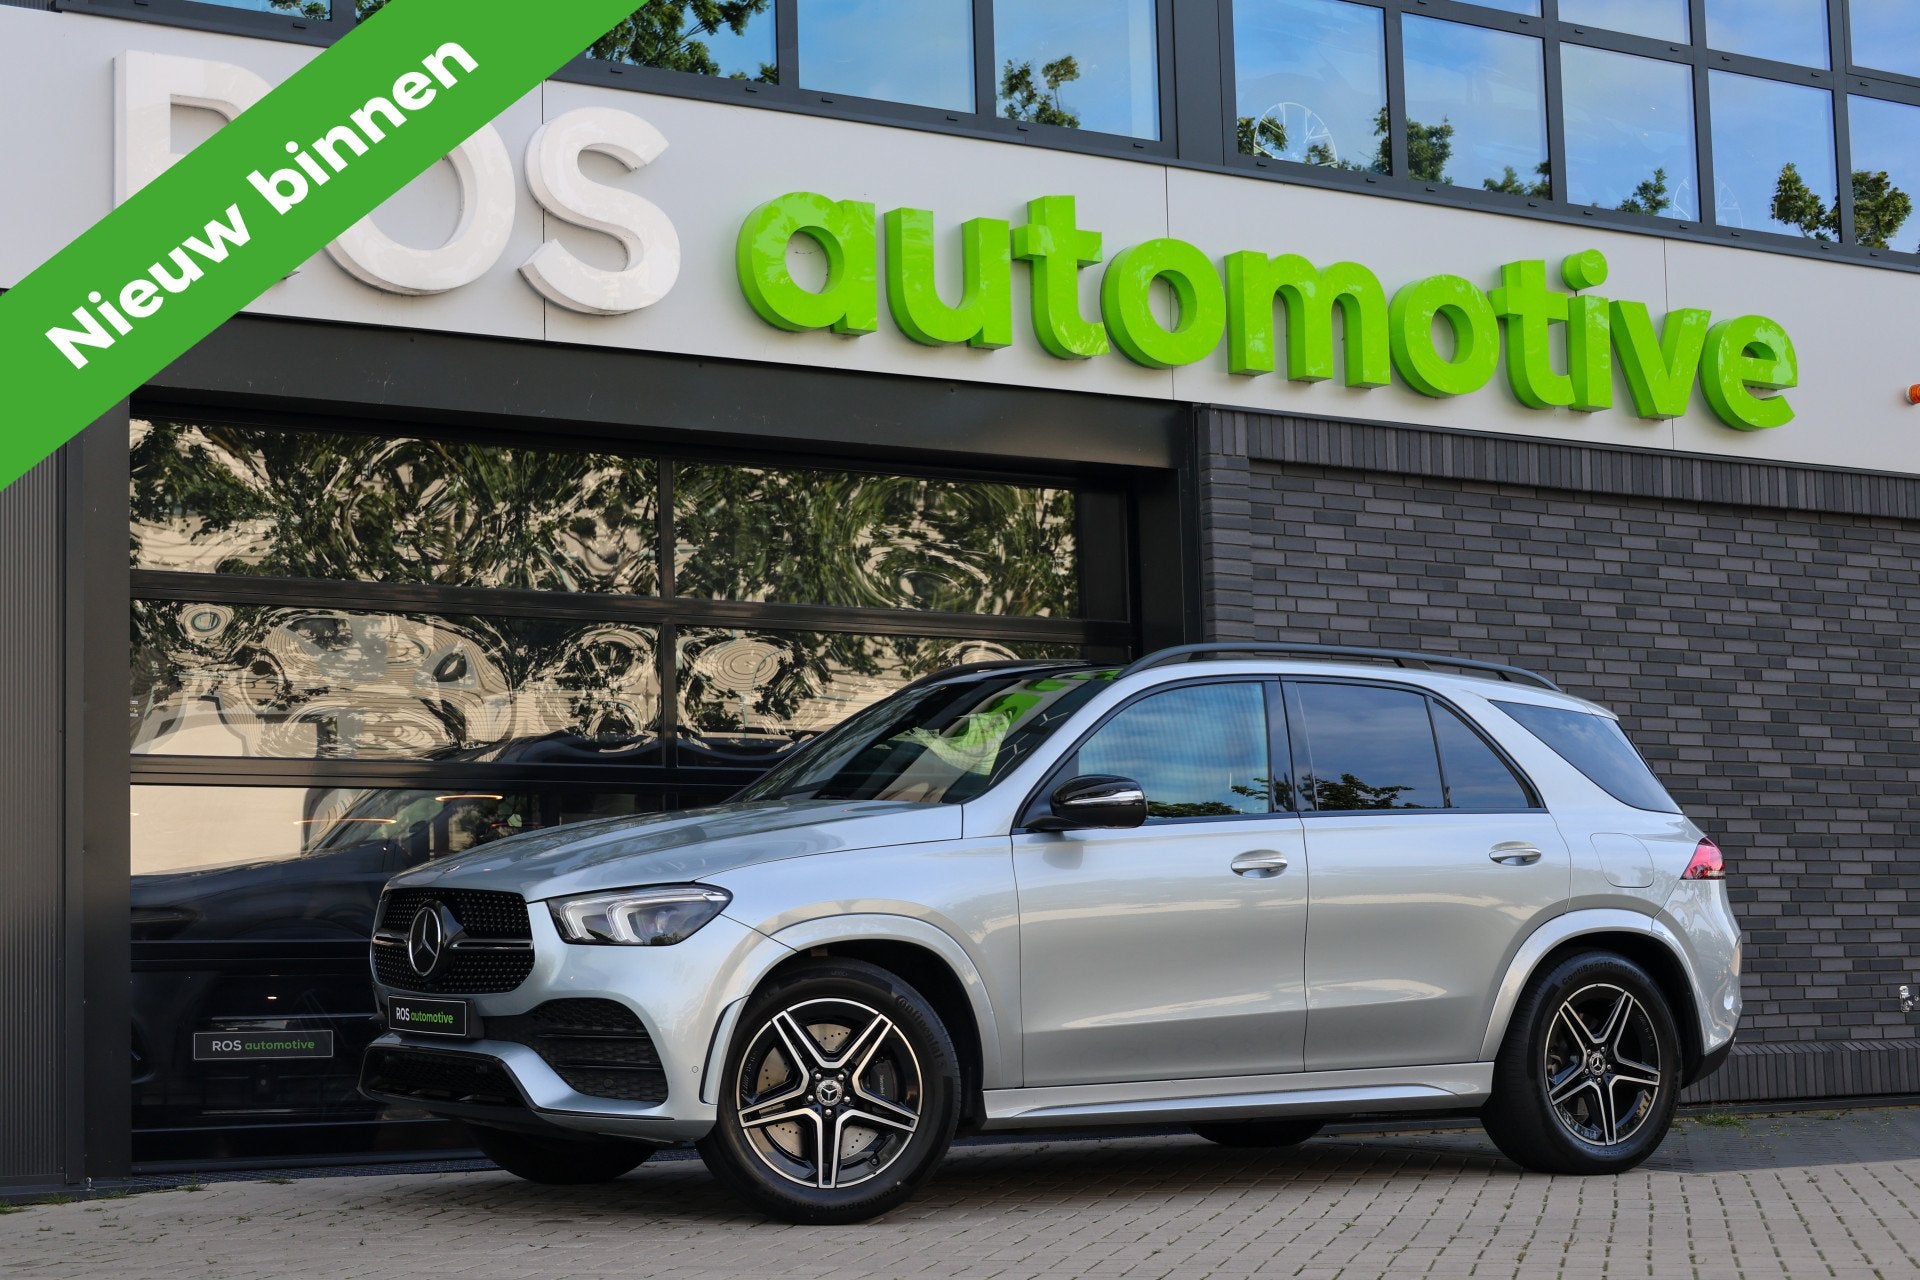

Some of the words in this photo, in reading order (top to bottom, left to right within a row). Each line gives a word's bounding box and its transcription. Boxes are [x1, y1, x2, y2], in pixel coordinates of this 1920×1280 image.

[736, 191, 1798, 431] automotive
[396, 1007, 410, 1022] ROS
[410, 1011, 454, 1024] automotive
[212, 1040, 242, 1051] ROS
[245, 1039, 315, 1051] automotive
